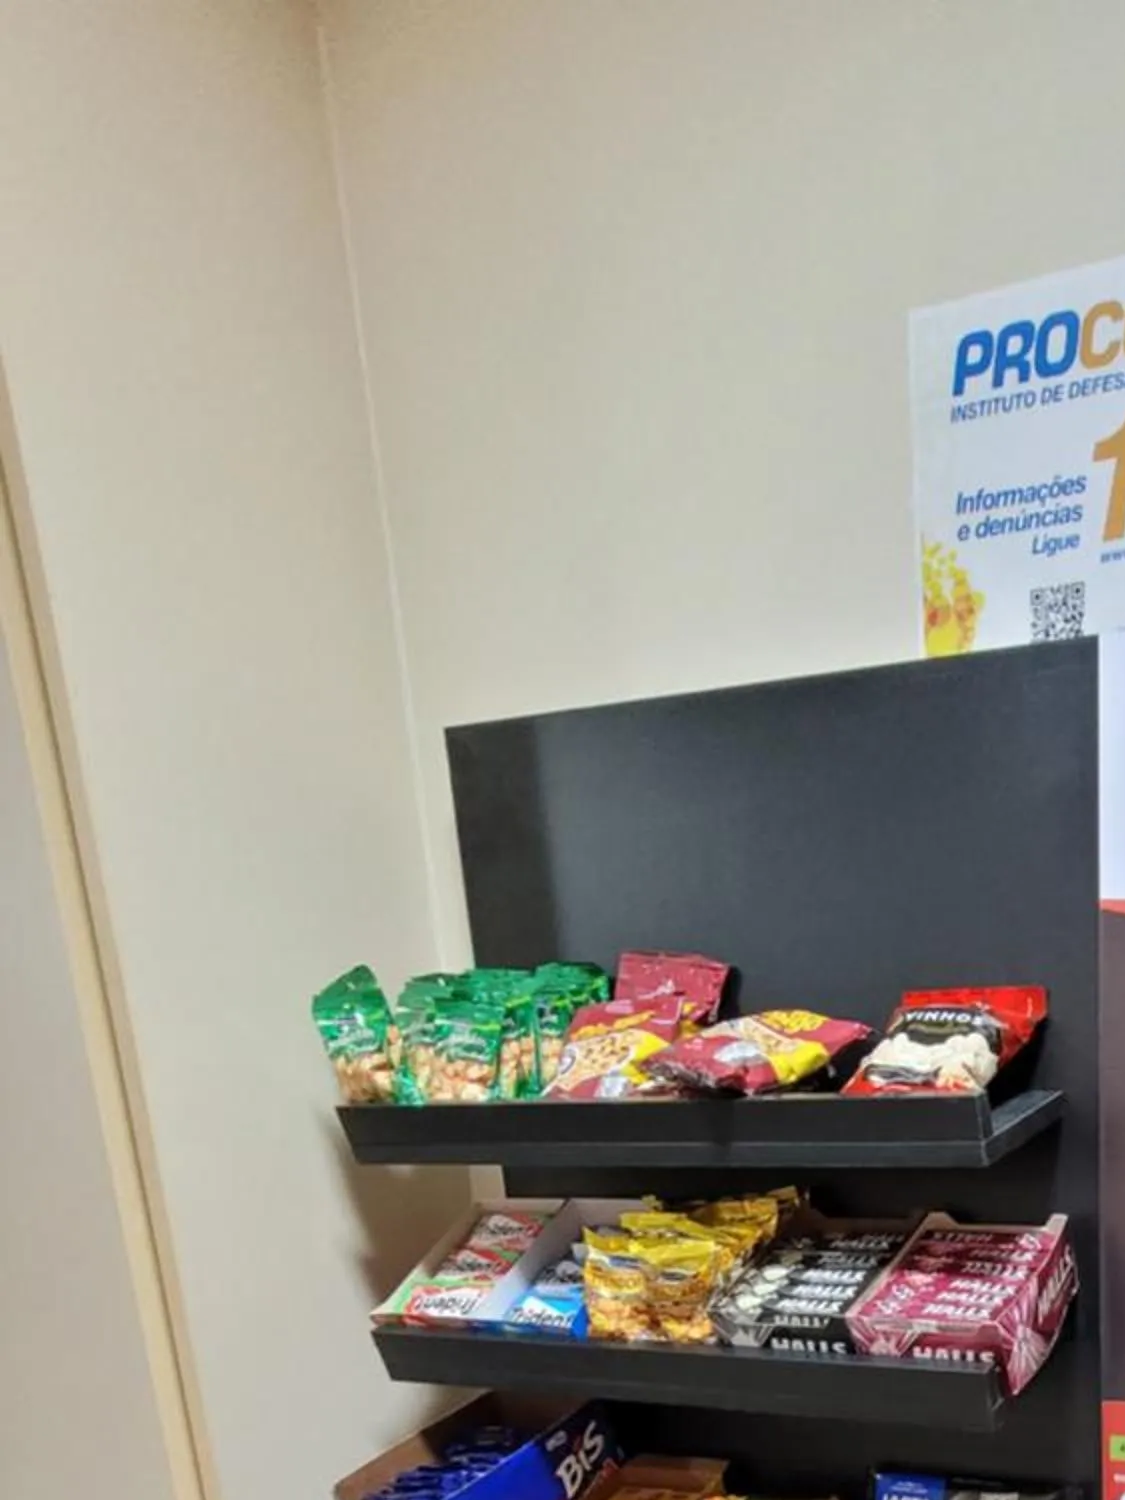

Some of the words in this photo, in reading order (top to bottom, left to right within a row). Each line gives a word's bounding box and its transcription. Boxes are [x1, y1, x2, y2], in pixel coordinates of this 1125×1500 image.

[950, 388, 1035, 423] INSTITUTO
[1041, 384, 1064, 406] DE
[956, 475, 1086, 514] Informações
[957, 525, 970, 541] e
[975, 504, 1083, 539] denúncias
[1031, 533, 1080, 556] Ligue
